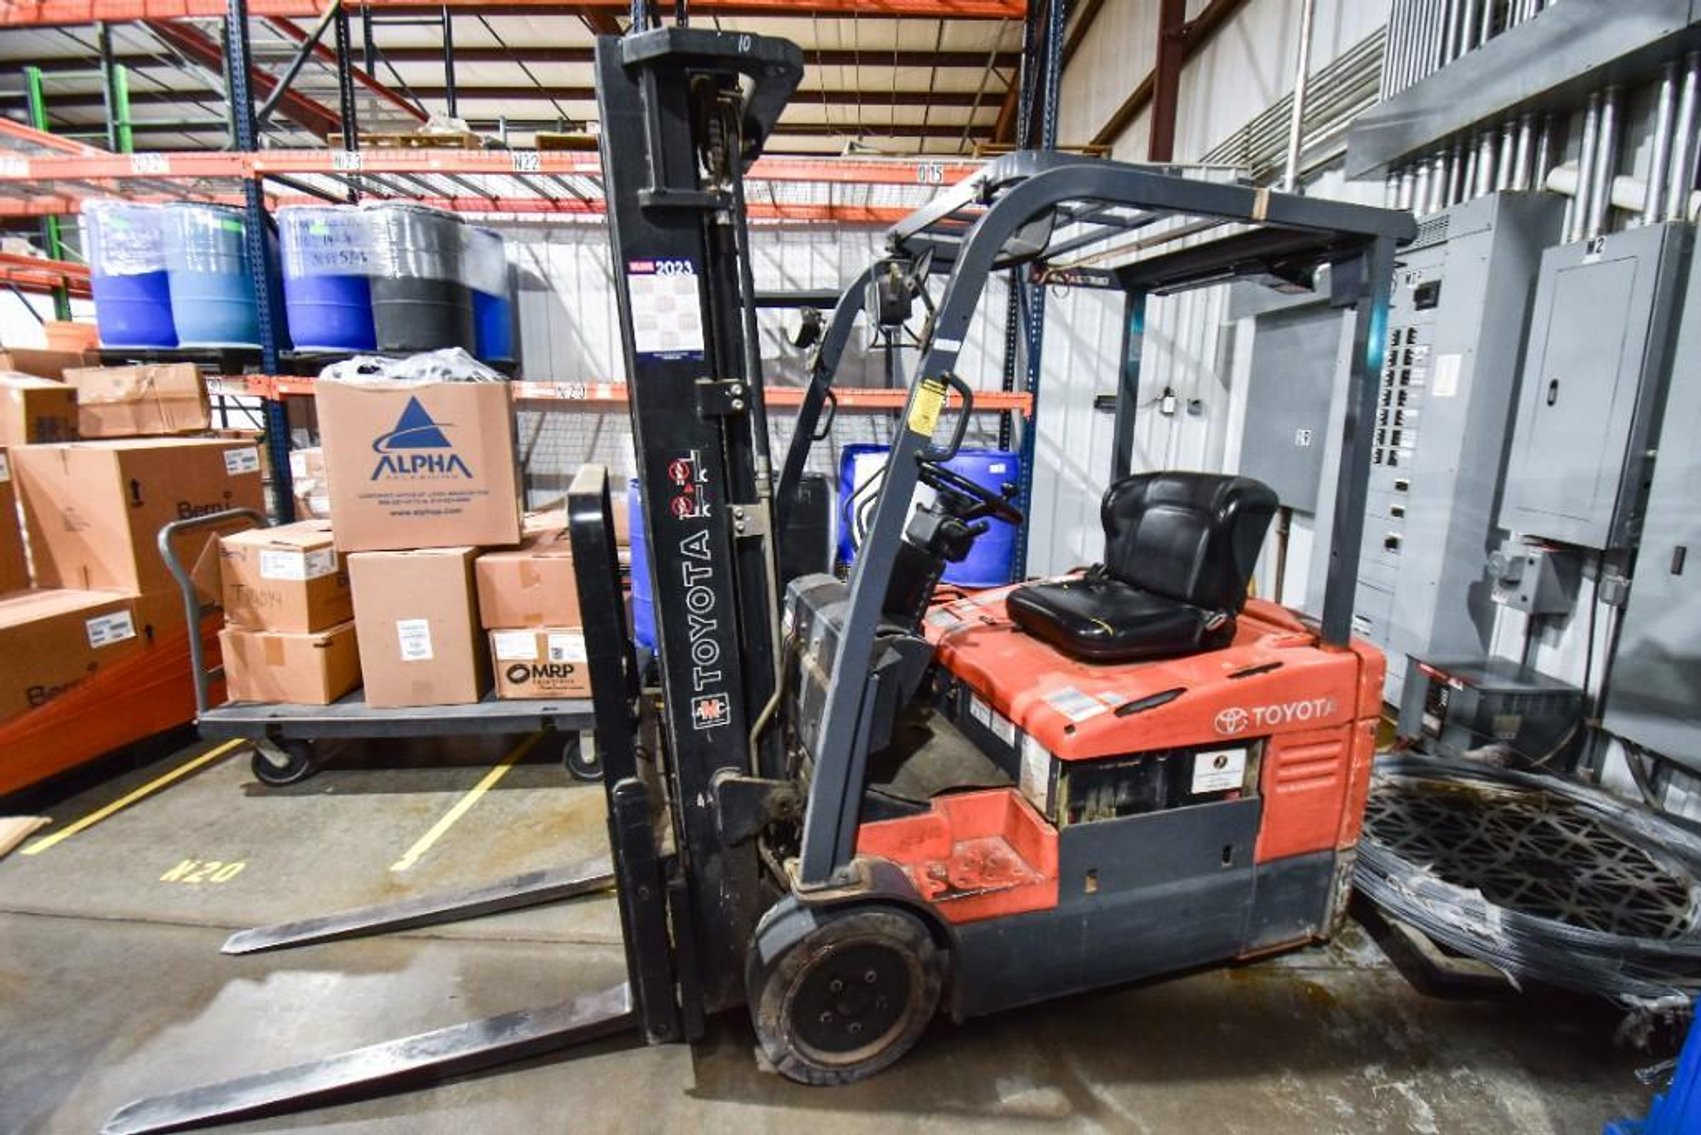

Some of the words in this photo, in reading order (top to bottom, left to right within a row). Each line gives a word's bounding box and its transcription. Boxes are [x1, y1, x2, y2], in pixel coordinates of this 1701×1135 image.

[514, 153, 540, 171] N22
[656, 261, 693, 275] 2023
[369, 454, 473, 480] ALPHA
[680, 530, 721, 691] TOYOTA
[532, 664, 574, 678] MRP
[160, 859, 246, 882] N20
